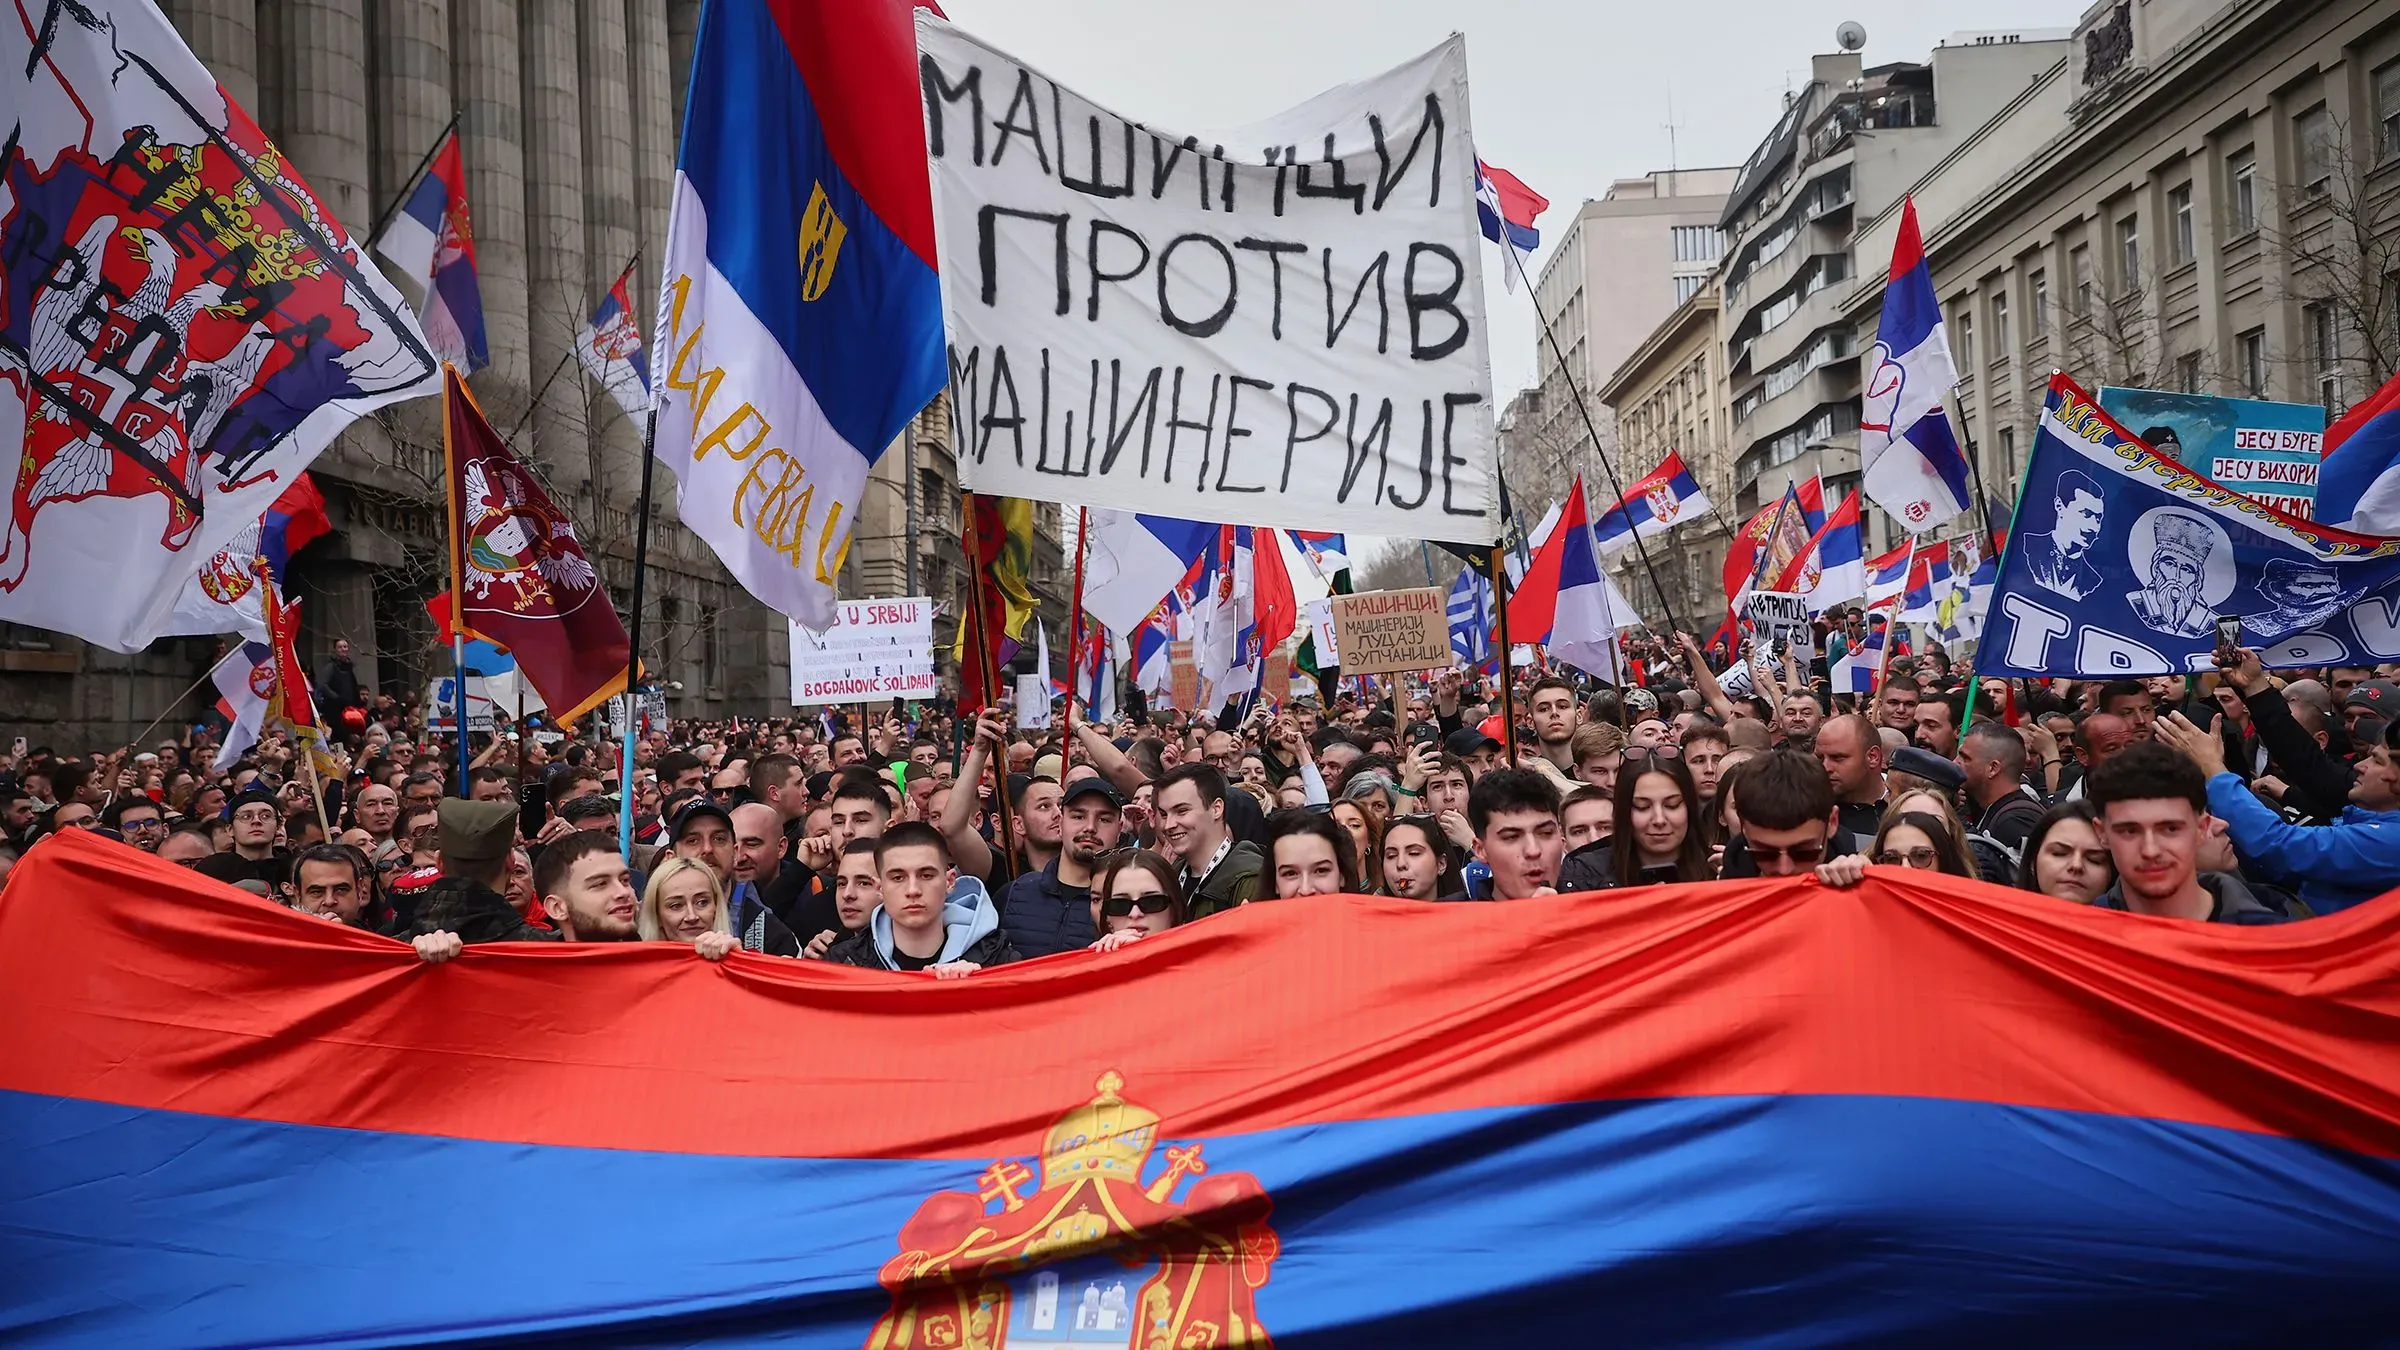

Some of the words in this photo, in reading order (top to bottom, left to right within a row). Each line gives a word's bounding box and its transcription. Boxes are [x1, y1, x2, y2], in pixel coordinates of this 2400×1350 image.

[978, 203, 1470, 361] ПРОТИВ
[2053, 389, 2114, 444] Ми
[947, 343, 1487, 517] МАШИНЕРИЈЕ
[2236, 430, 2276, 449] ЈЕСУ
[2282, 432, 2318, 452] БУРЕ
[2214, 458, 2251, 479] ЈЕСУ
[2258, 463, 2316, 485] ВИХОРИ
[847, 606, 859, 625] U
[1344, 592, 1439, 617] МАШИНЦИ!
[1345, 615, 1424, 636] МАШИНЕРИЈИ
[1347, 645, 1445, 666] ЗУПЧАНИЦИ
